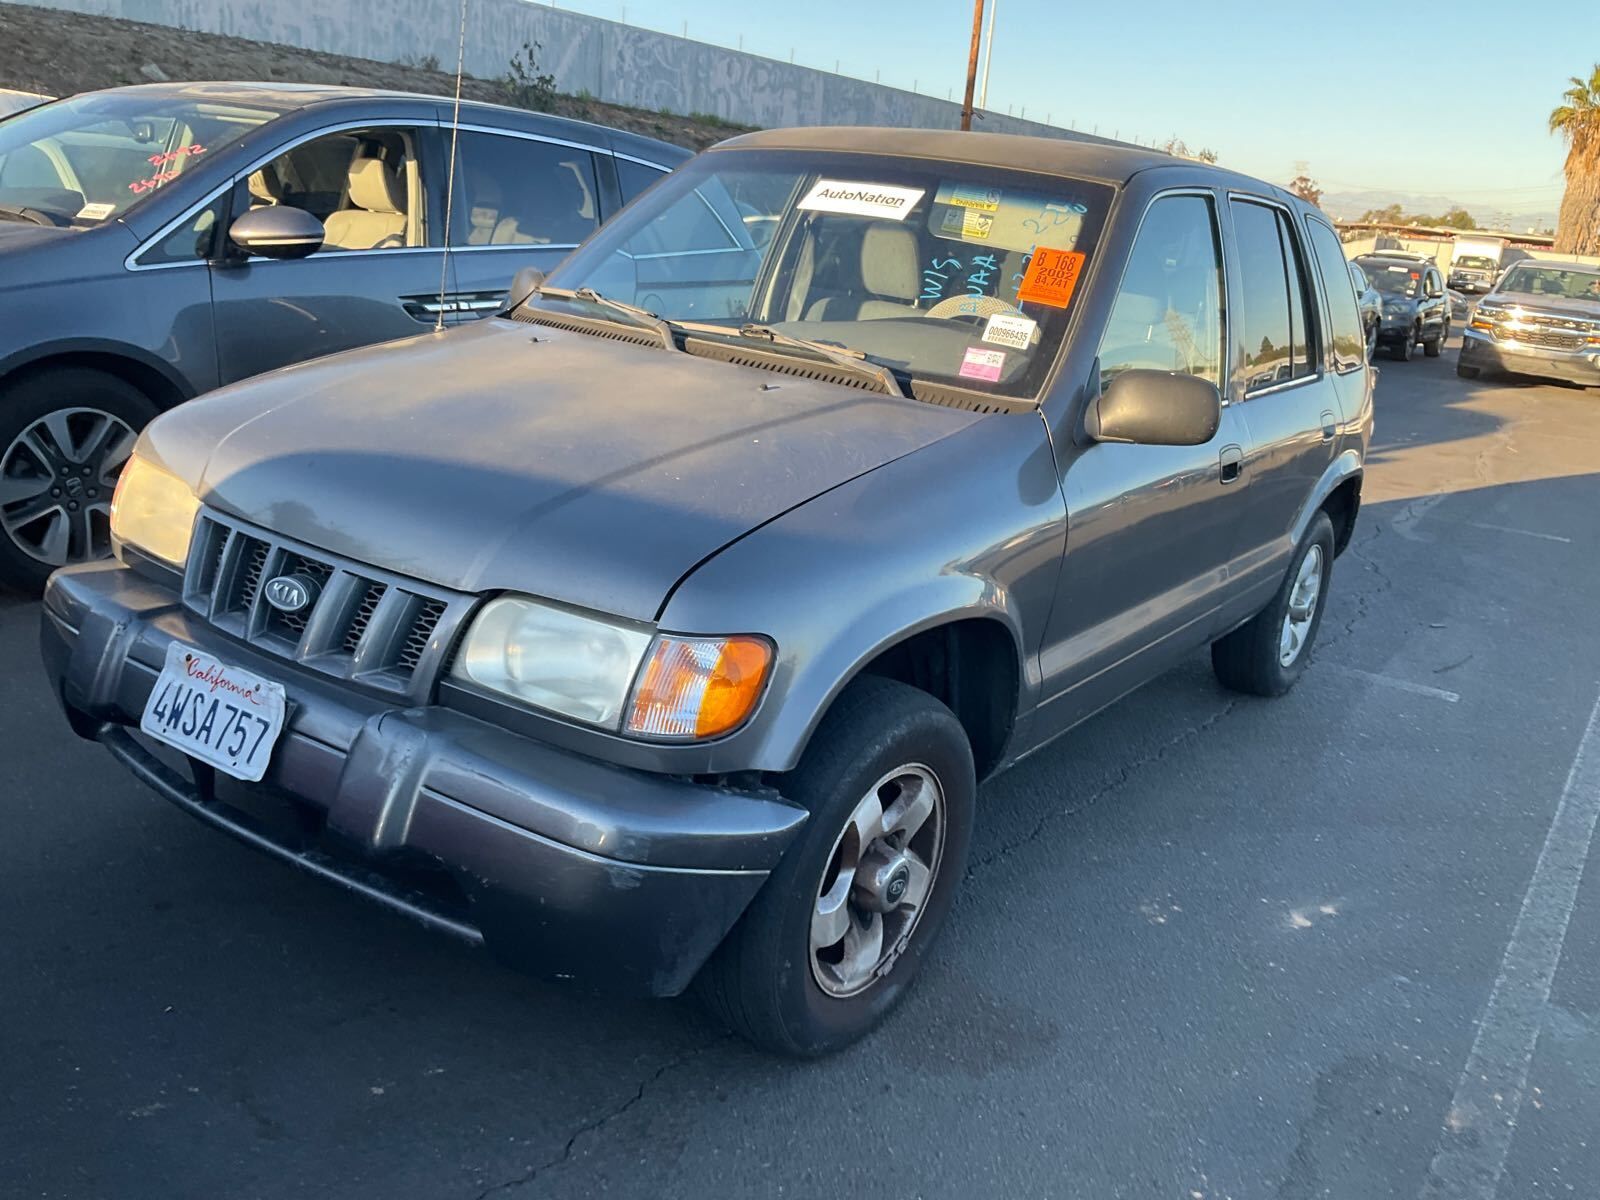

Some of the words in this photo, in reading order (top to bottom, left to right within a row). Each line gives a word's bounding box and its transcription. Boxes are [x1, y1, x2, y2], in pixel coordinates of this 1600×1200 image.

[816, 188, 906, 207] AutoNation
[1054, 254, 1077, 272] 168
[1038, 267, 1074, 281] 2002
[988, 325, 1029, 342] 000966435
[273, 582, 298, 606] KIA
[187, 657, 261, 705] California
[152, 682, 271, 765] 4WSA757
